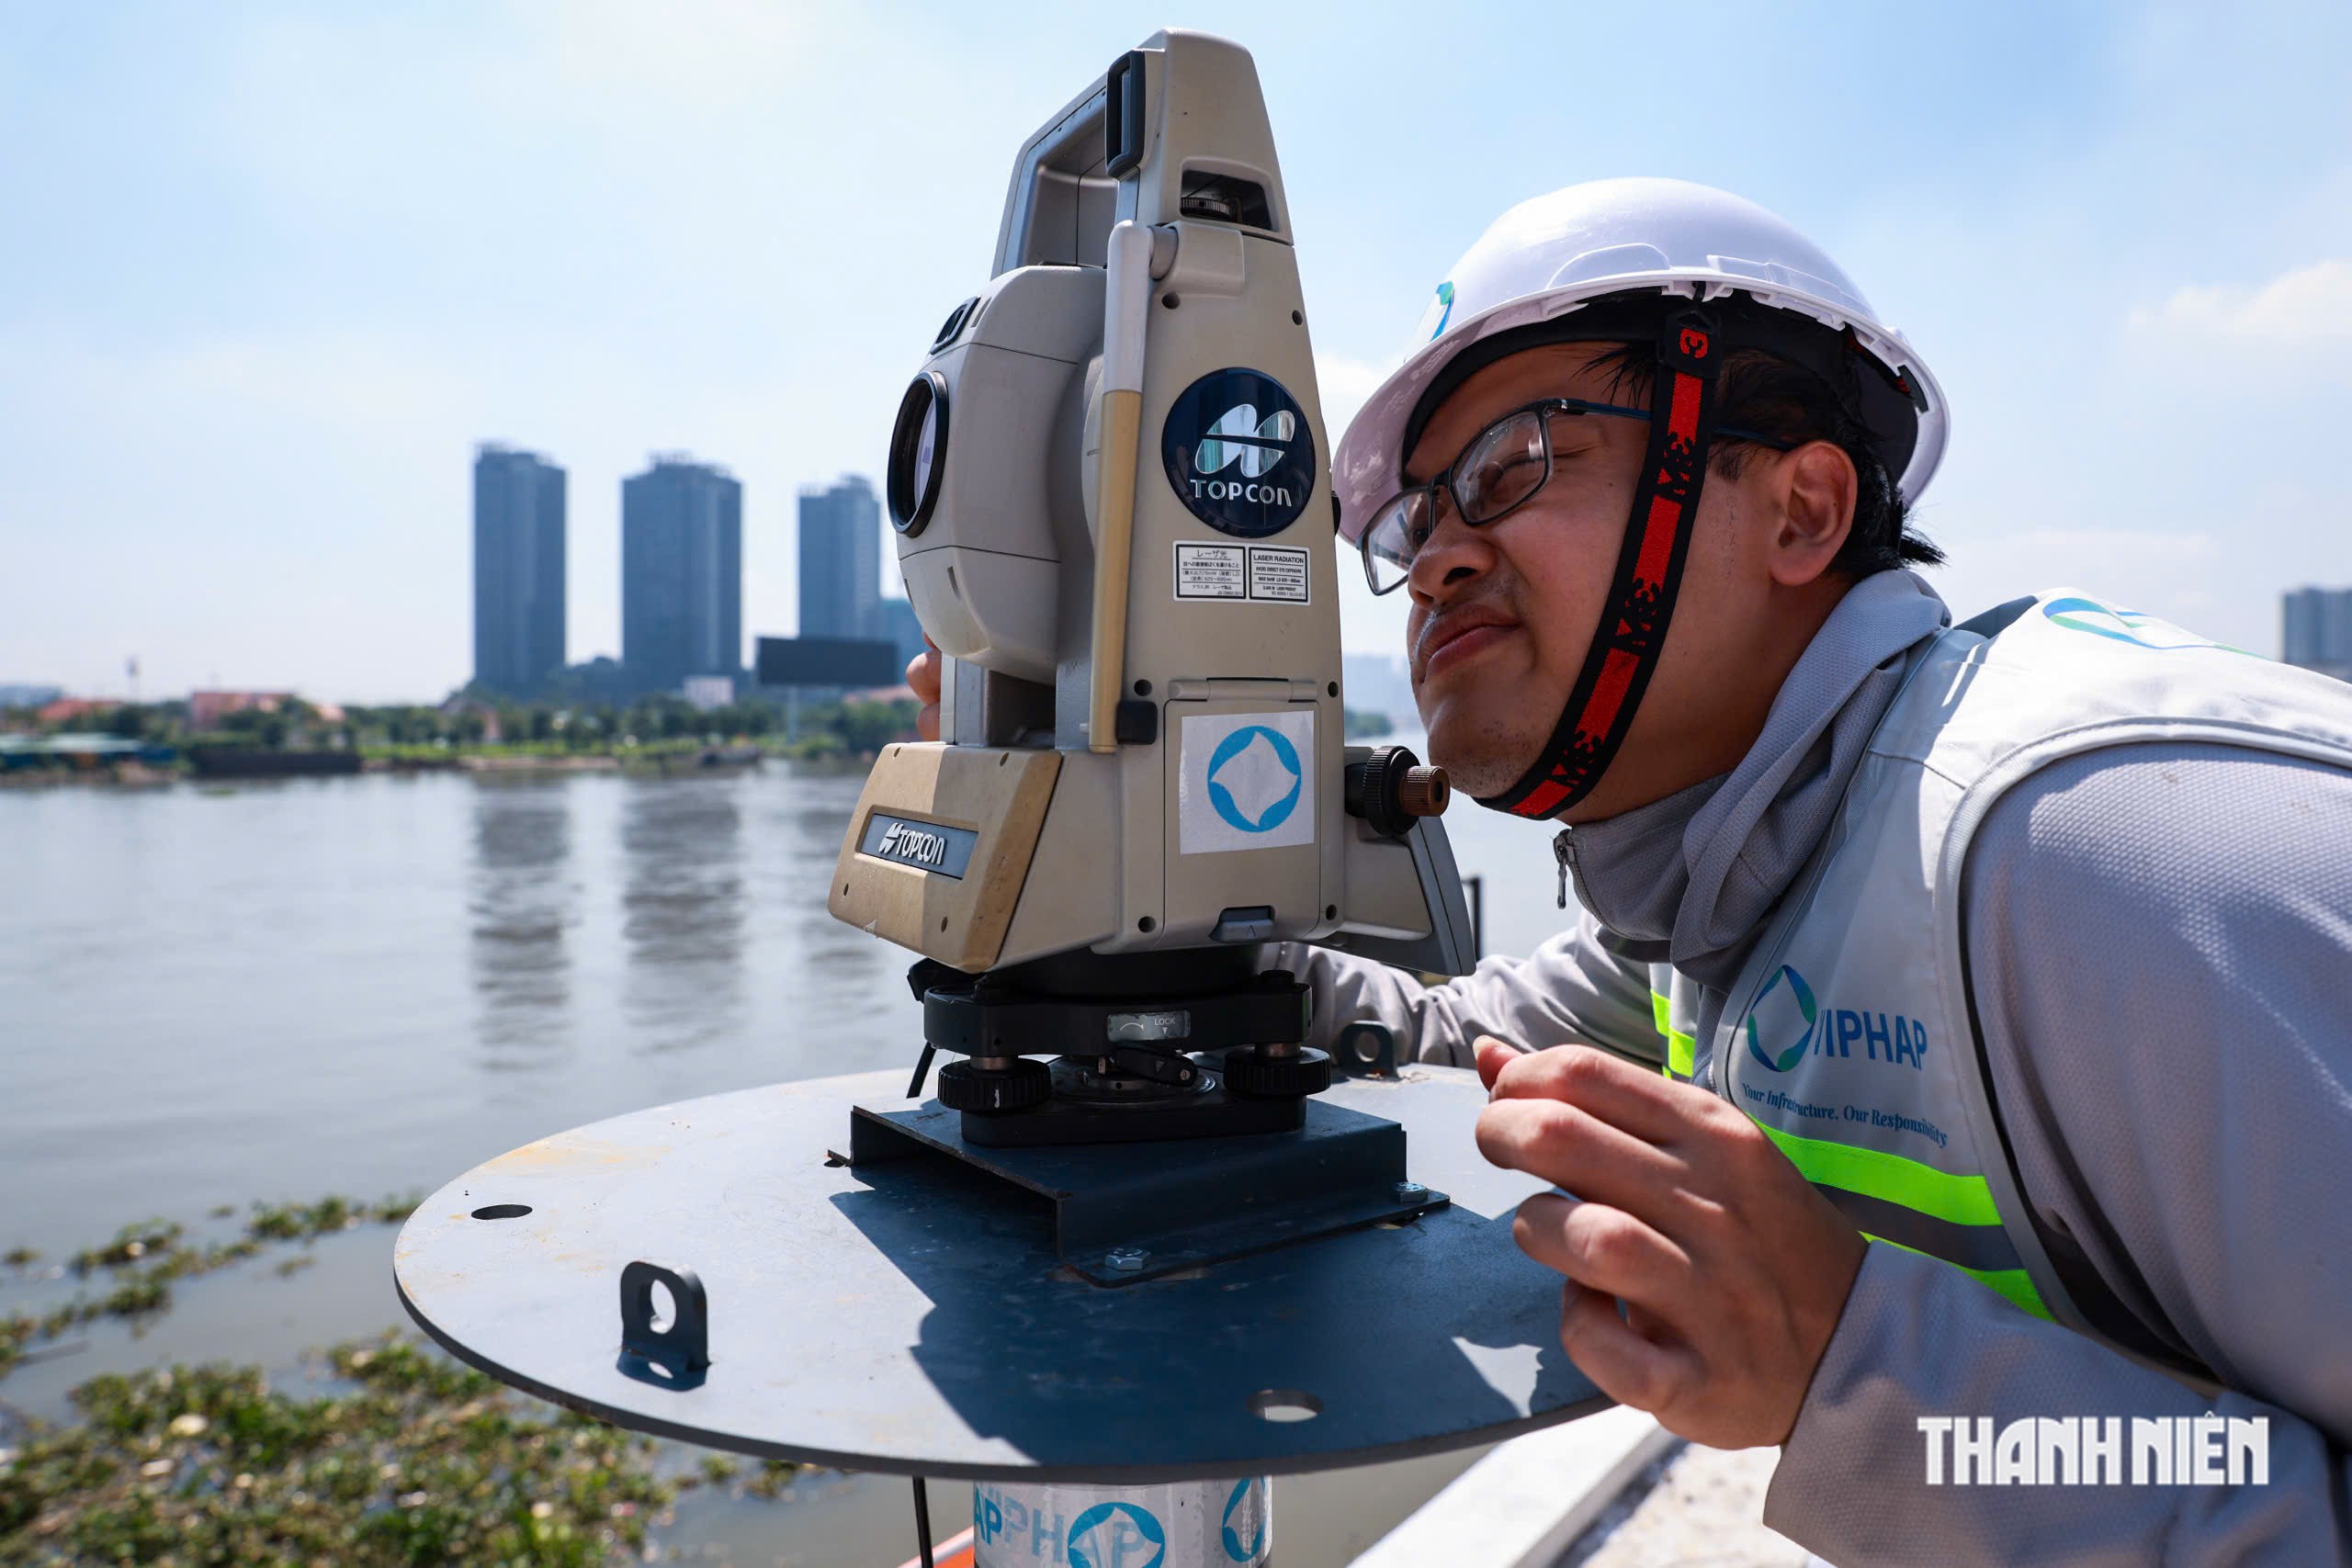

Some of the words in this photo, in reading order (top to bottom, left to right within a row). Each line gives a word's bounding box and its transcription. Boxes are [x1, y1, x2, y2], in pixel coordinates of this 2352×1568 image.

[1190, 479, 1293, 507] TOPCON
[895, 829, 946, 865] TOPCON
[1154, 1018, 1176, 1026] LOCK
[1843, 1104, 1869, 1122] Our
